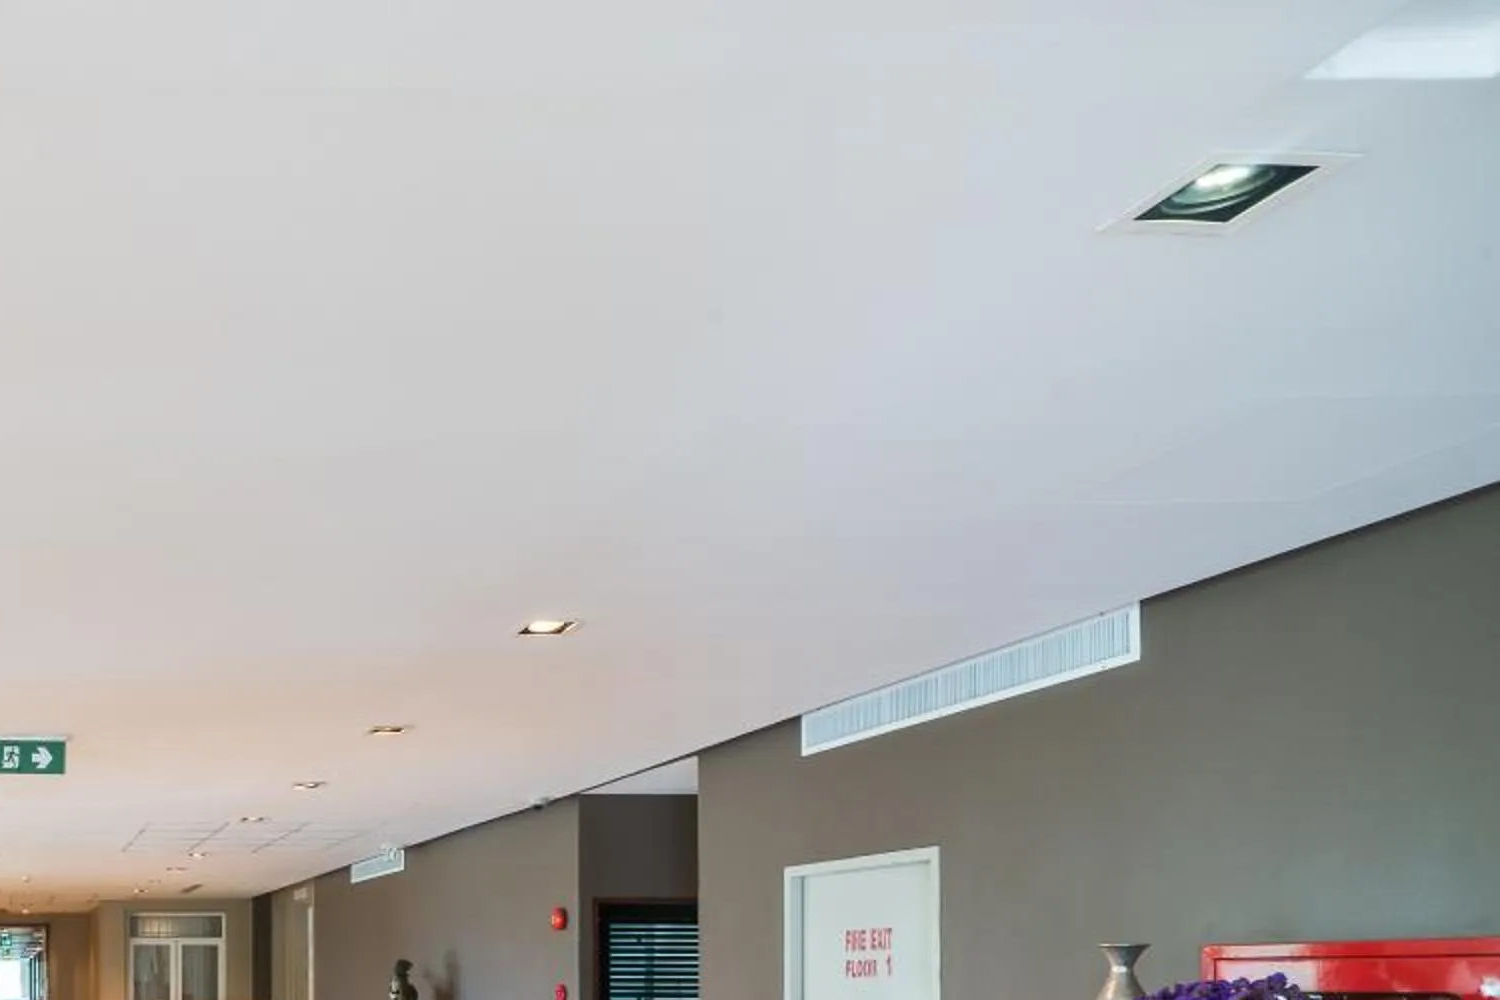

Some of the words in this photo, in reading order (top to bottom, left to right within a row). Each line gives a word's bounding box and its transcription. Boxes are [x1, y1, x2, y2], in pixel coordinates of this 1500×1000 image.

[845, 929, 867, 951] FIRE
[870, 927, 893, 951] EXIT
[845, 959, 877, 978] FLOOR
